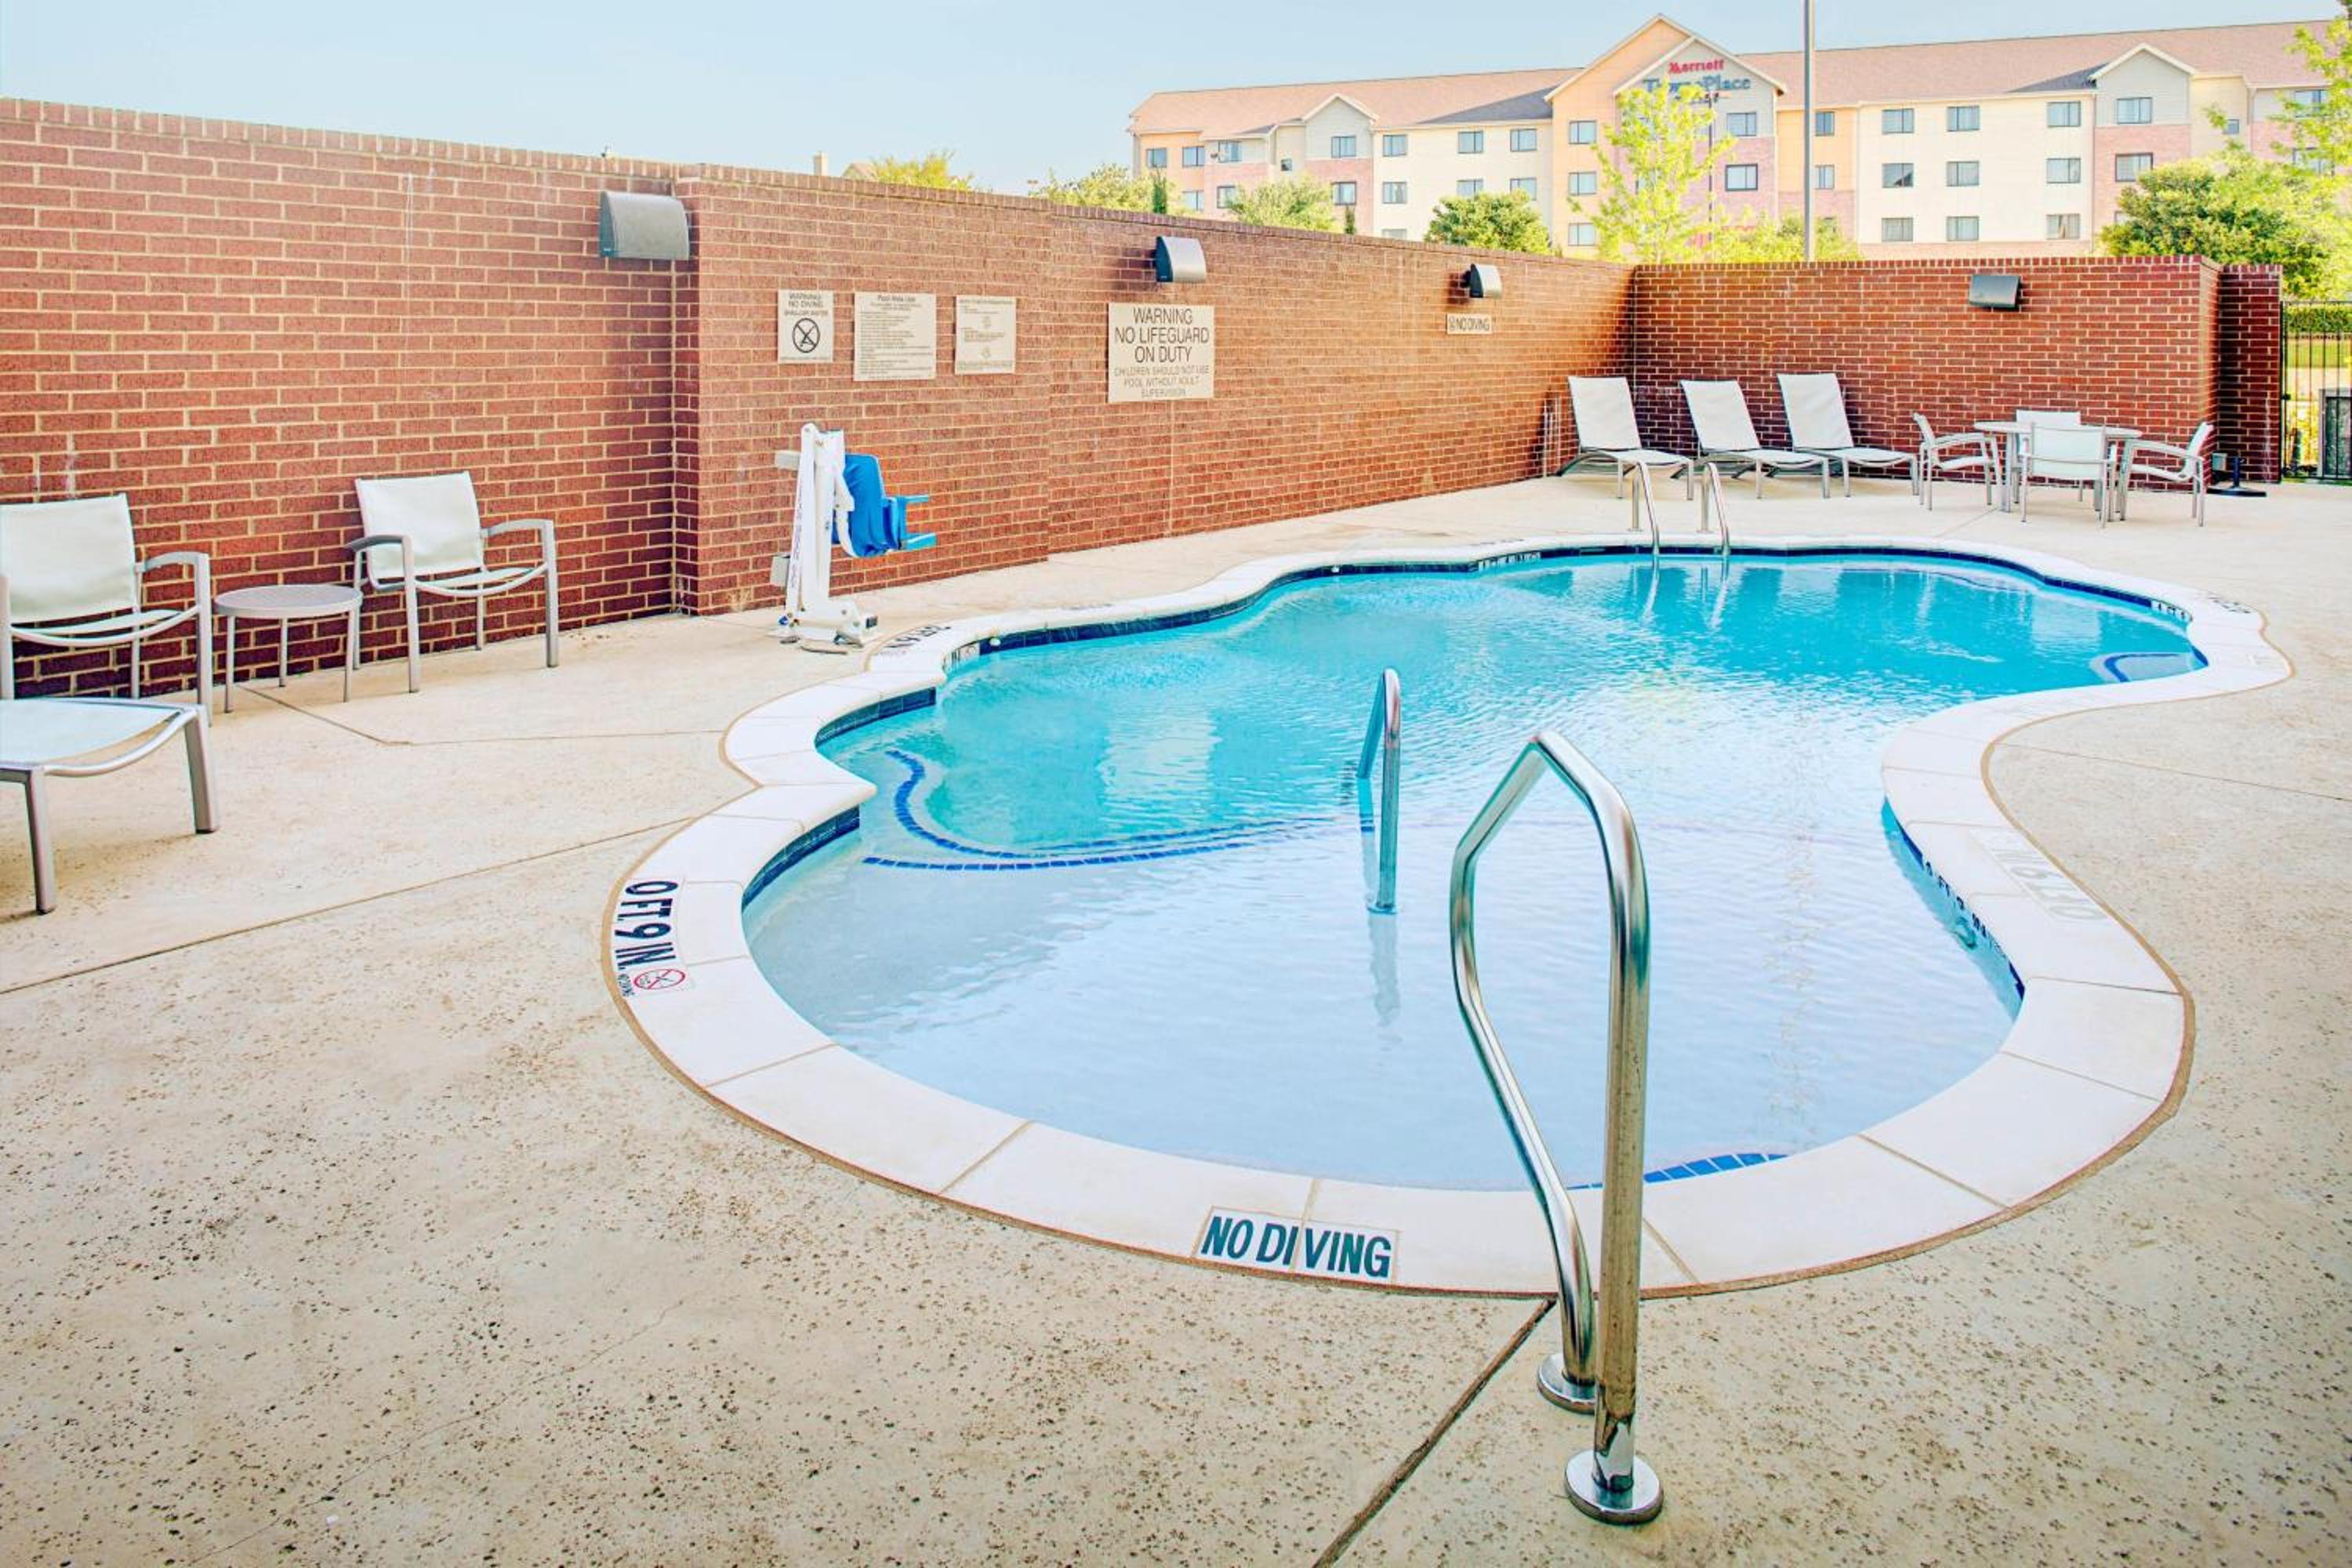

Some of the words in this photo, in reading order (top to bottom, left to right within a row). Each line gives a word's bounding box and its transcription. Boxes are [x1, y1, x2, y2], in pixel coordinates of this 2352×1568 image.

[1668, 59, 1725, 74] Marriott
[1133, 307, 1192, 325] WARNING
[1115, 327, 1136, 343] NO
[1139, 327, 1209, 344] LIFEGUARD
[1134, 347, 1155, 363] ON
[1160, 347, 1192, 362] DUTY
[1114, 367, 1150, 376] CHILDREN
[615, 923, 672, 939] 9
[1201, 1215, 1254, 1259] NO
[1255, 1222, 1392, 1279] DIVING
